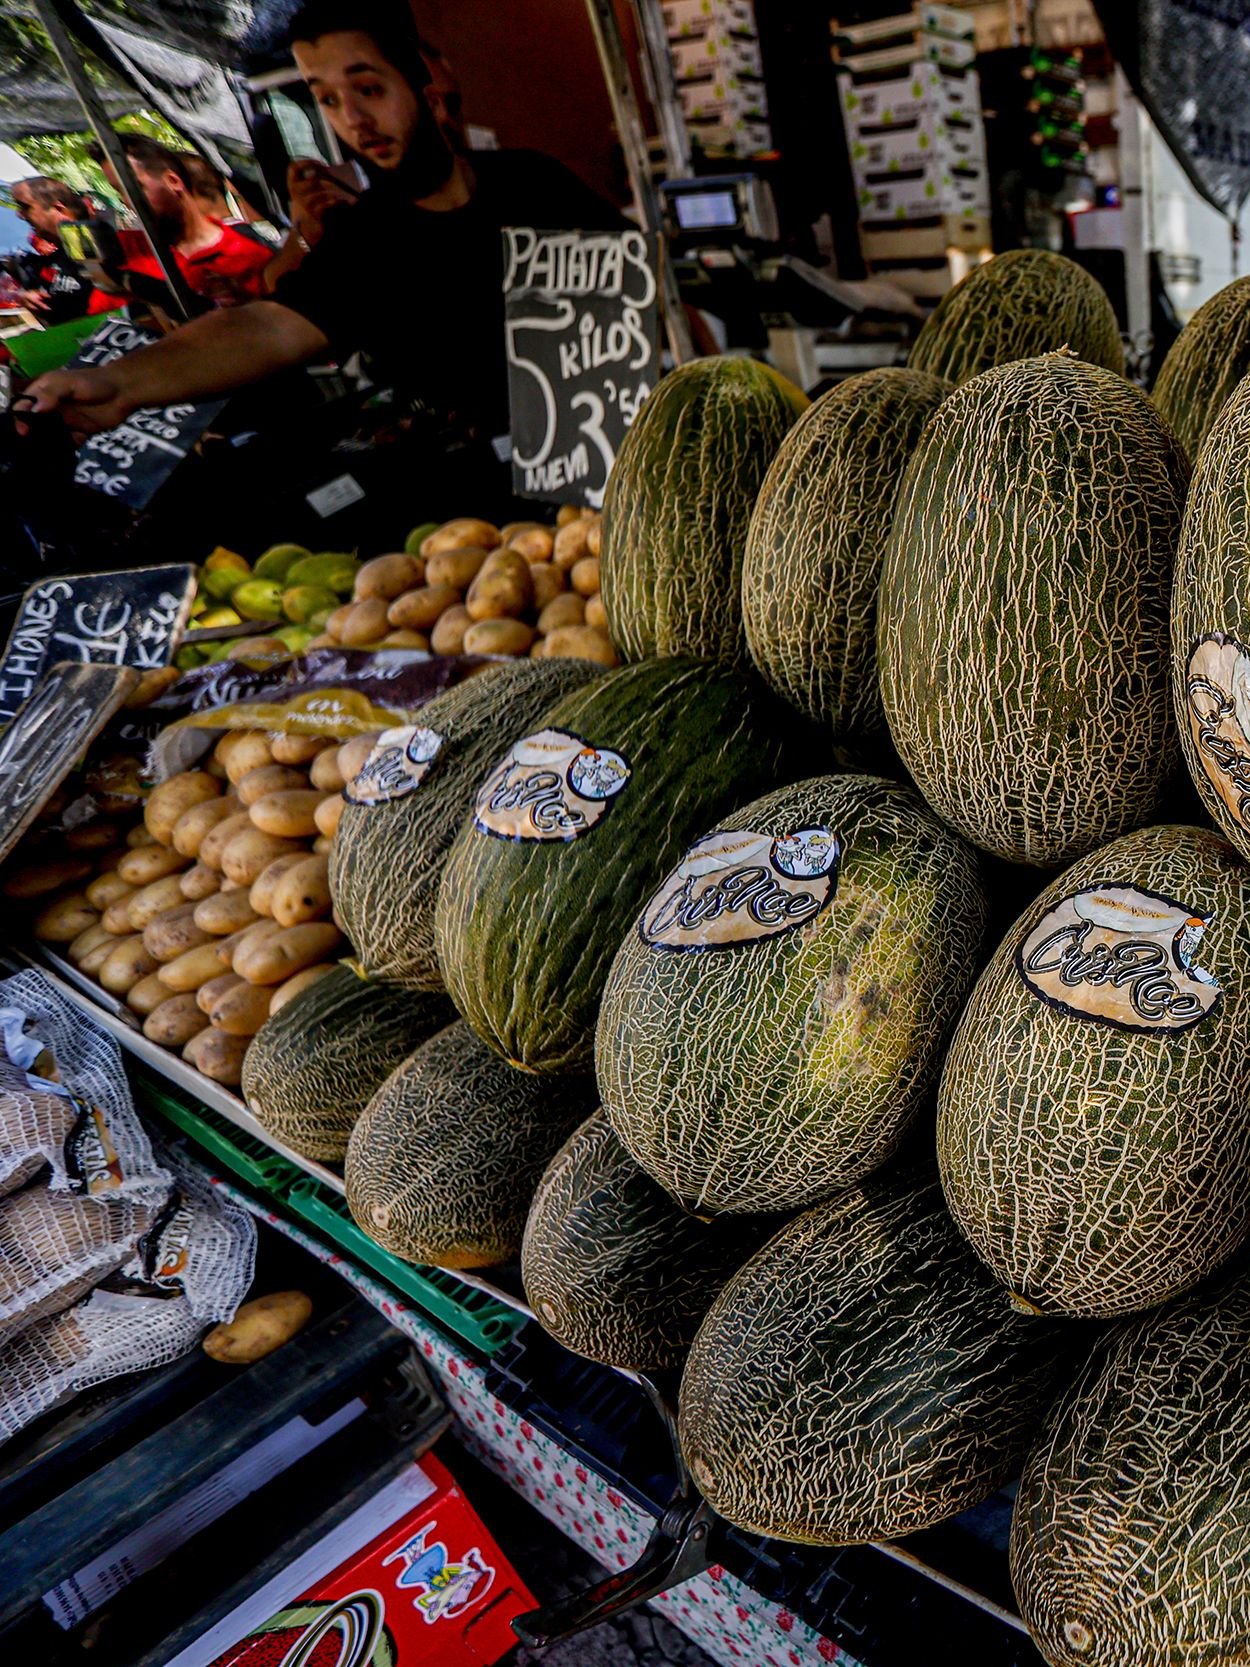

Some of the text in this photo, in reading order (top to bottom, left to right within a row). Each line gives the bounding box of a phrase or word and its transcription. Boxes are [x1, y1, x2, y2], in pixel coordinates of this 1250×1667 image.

[502, 227, 656, 309] PATATAS
[505, 300, 576, 470] 5
[131, 591, 181, 669] KILO
